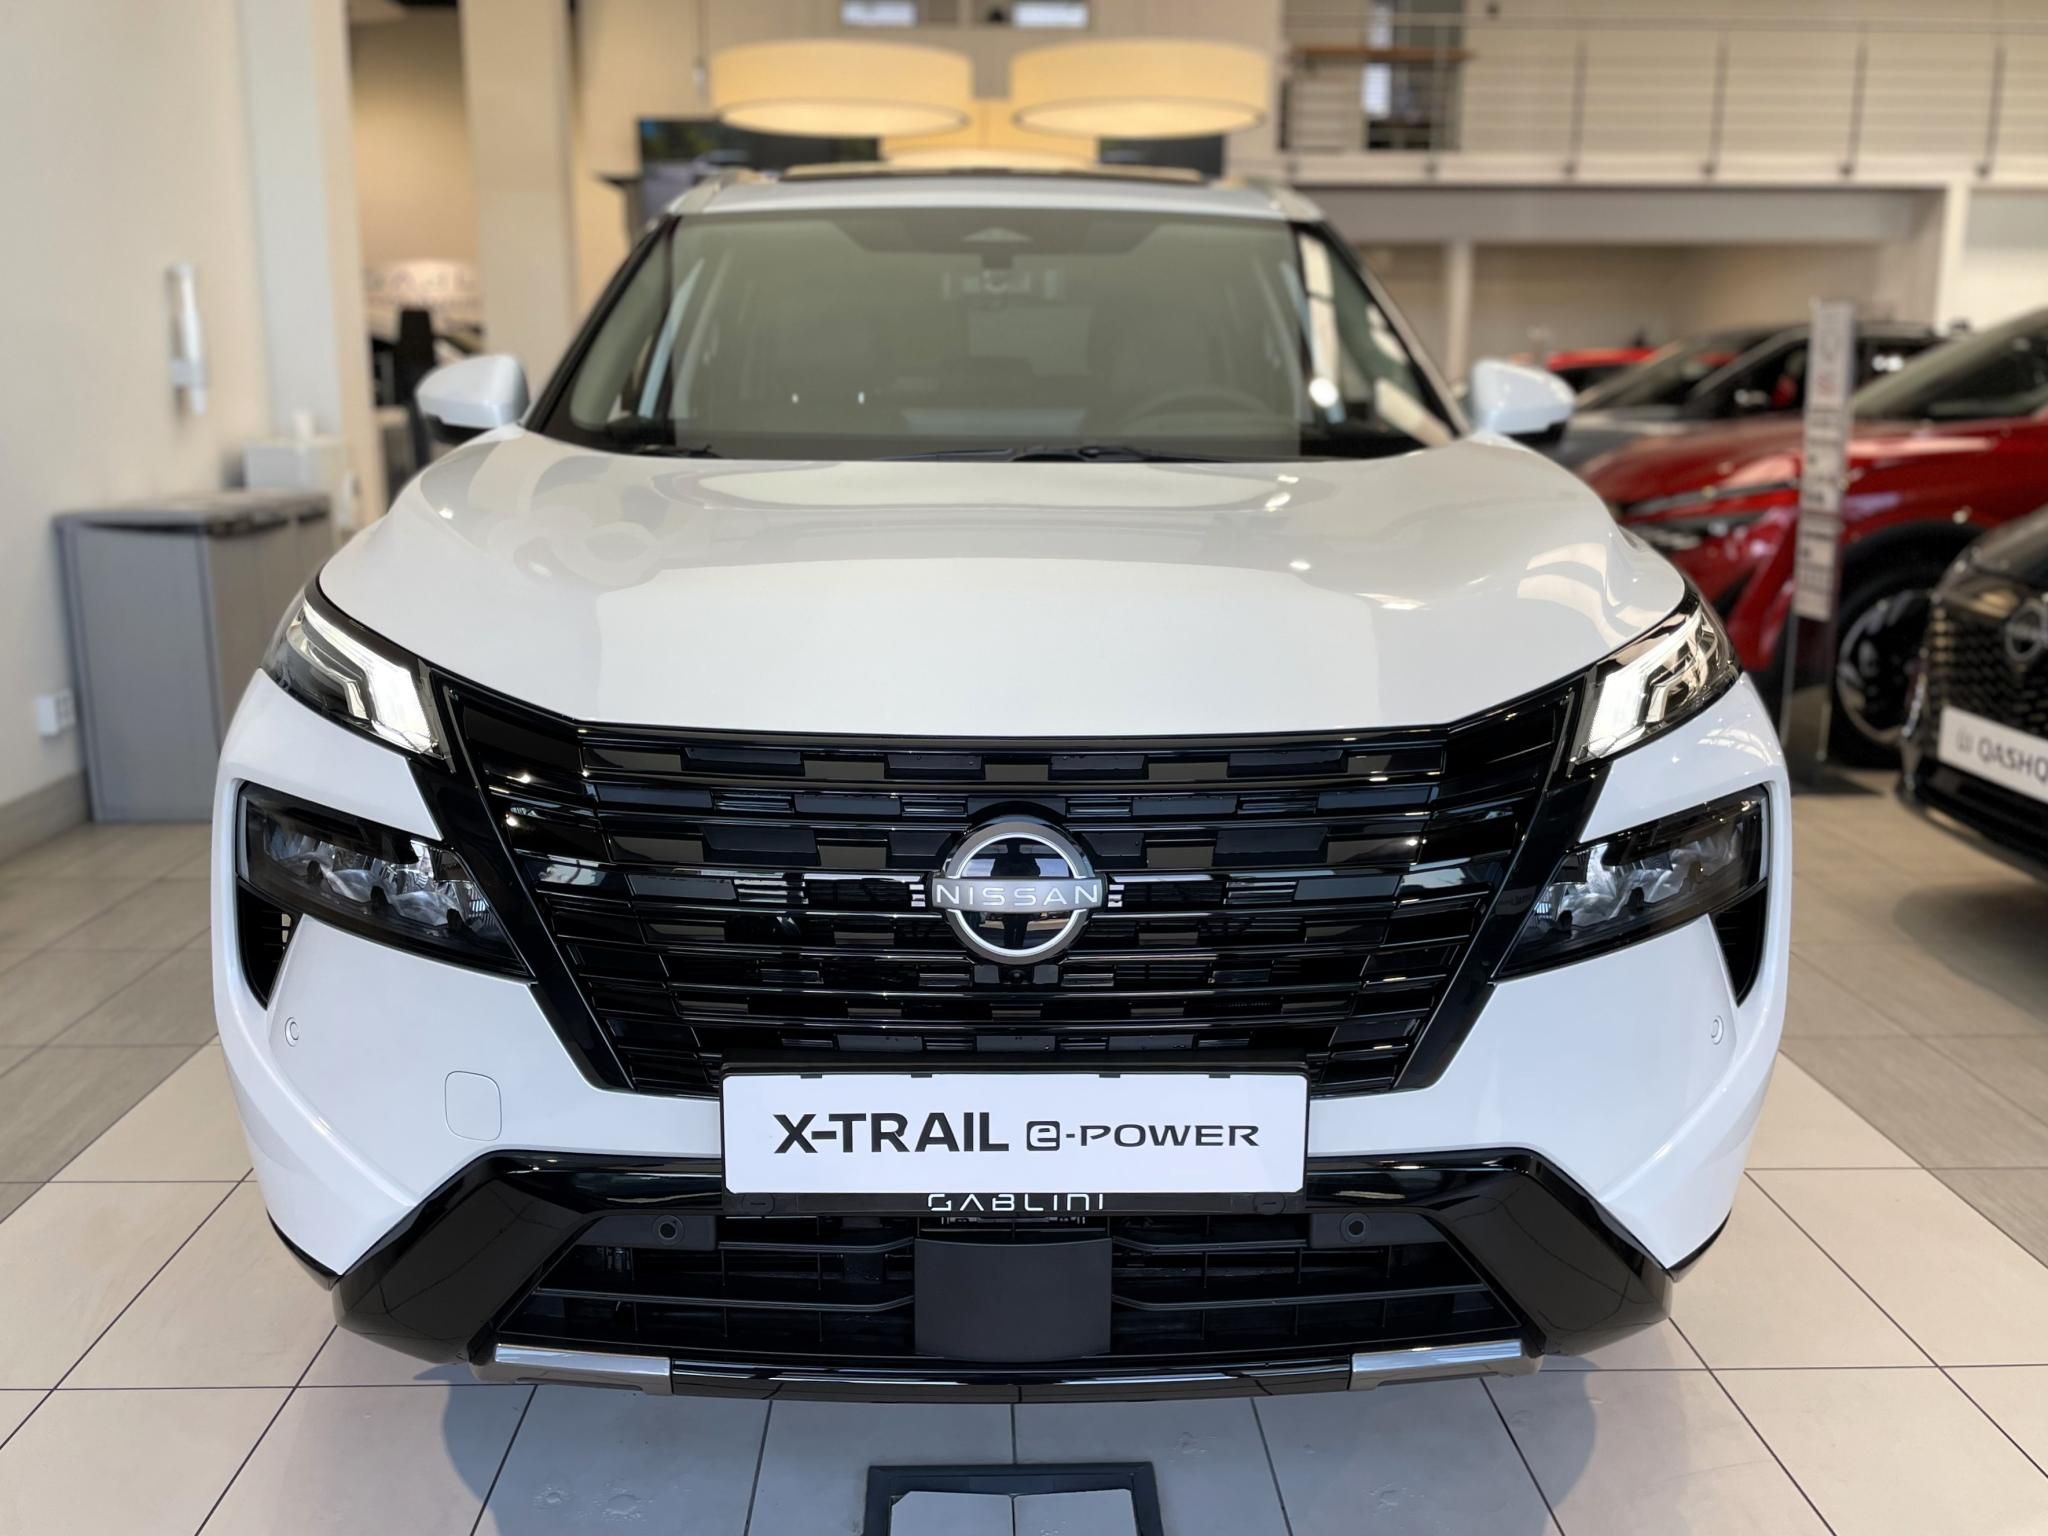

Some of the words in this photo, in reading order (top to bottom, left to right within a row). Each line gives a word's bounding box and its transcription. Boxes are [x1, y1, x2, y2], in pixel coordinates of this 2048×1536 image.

[936, 884, 1097, 906] NISSAN
[773, 1112, 1010, 1154] X-TRAIL
[1026, 1120, 1260, 1151] e-POWER
[927, 1193, 1104, 1212] GABLINI
